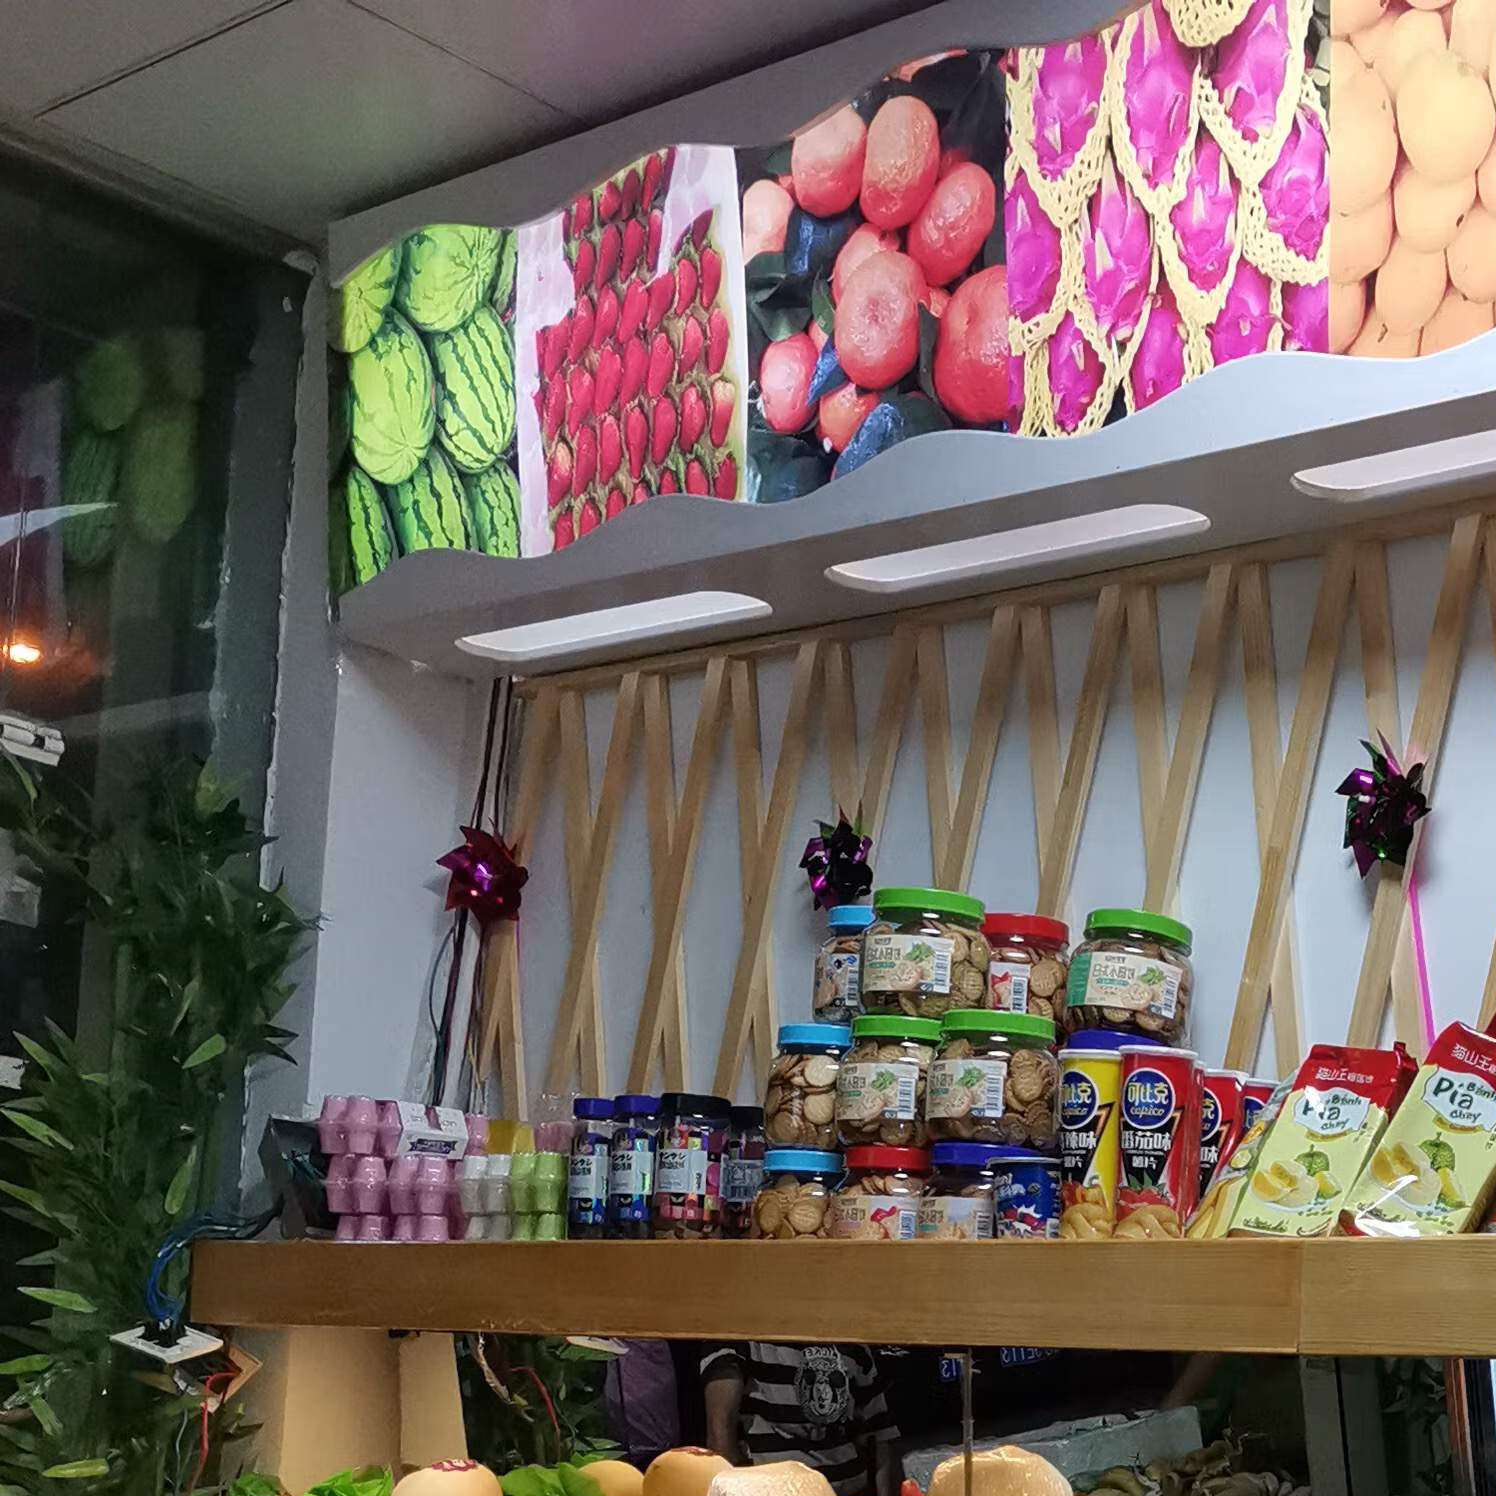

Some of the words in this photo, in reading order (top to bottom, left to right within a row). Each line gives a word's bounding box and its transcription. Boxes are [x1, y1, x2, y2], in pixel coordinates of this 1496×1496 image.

[1127, 1076, 1169, 1105] 可比克
[1121, 1130, 1172, 1150] 番茄味
